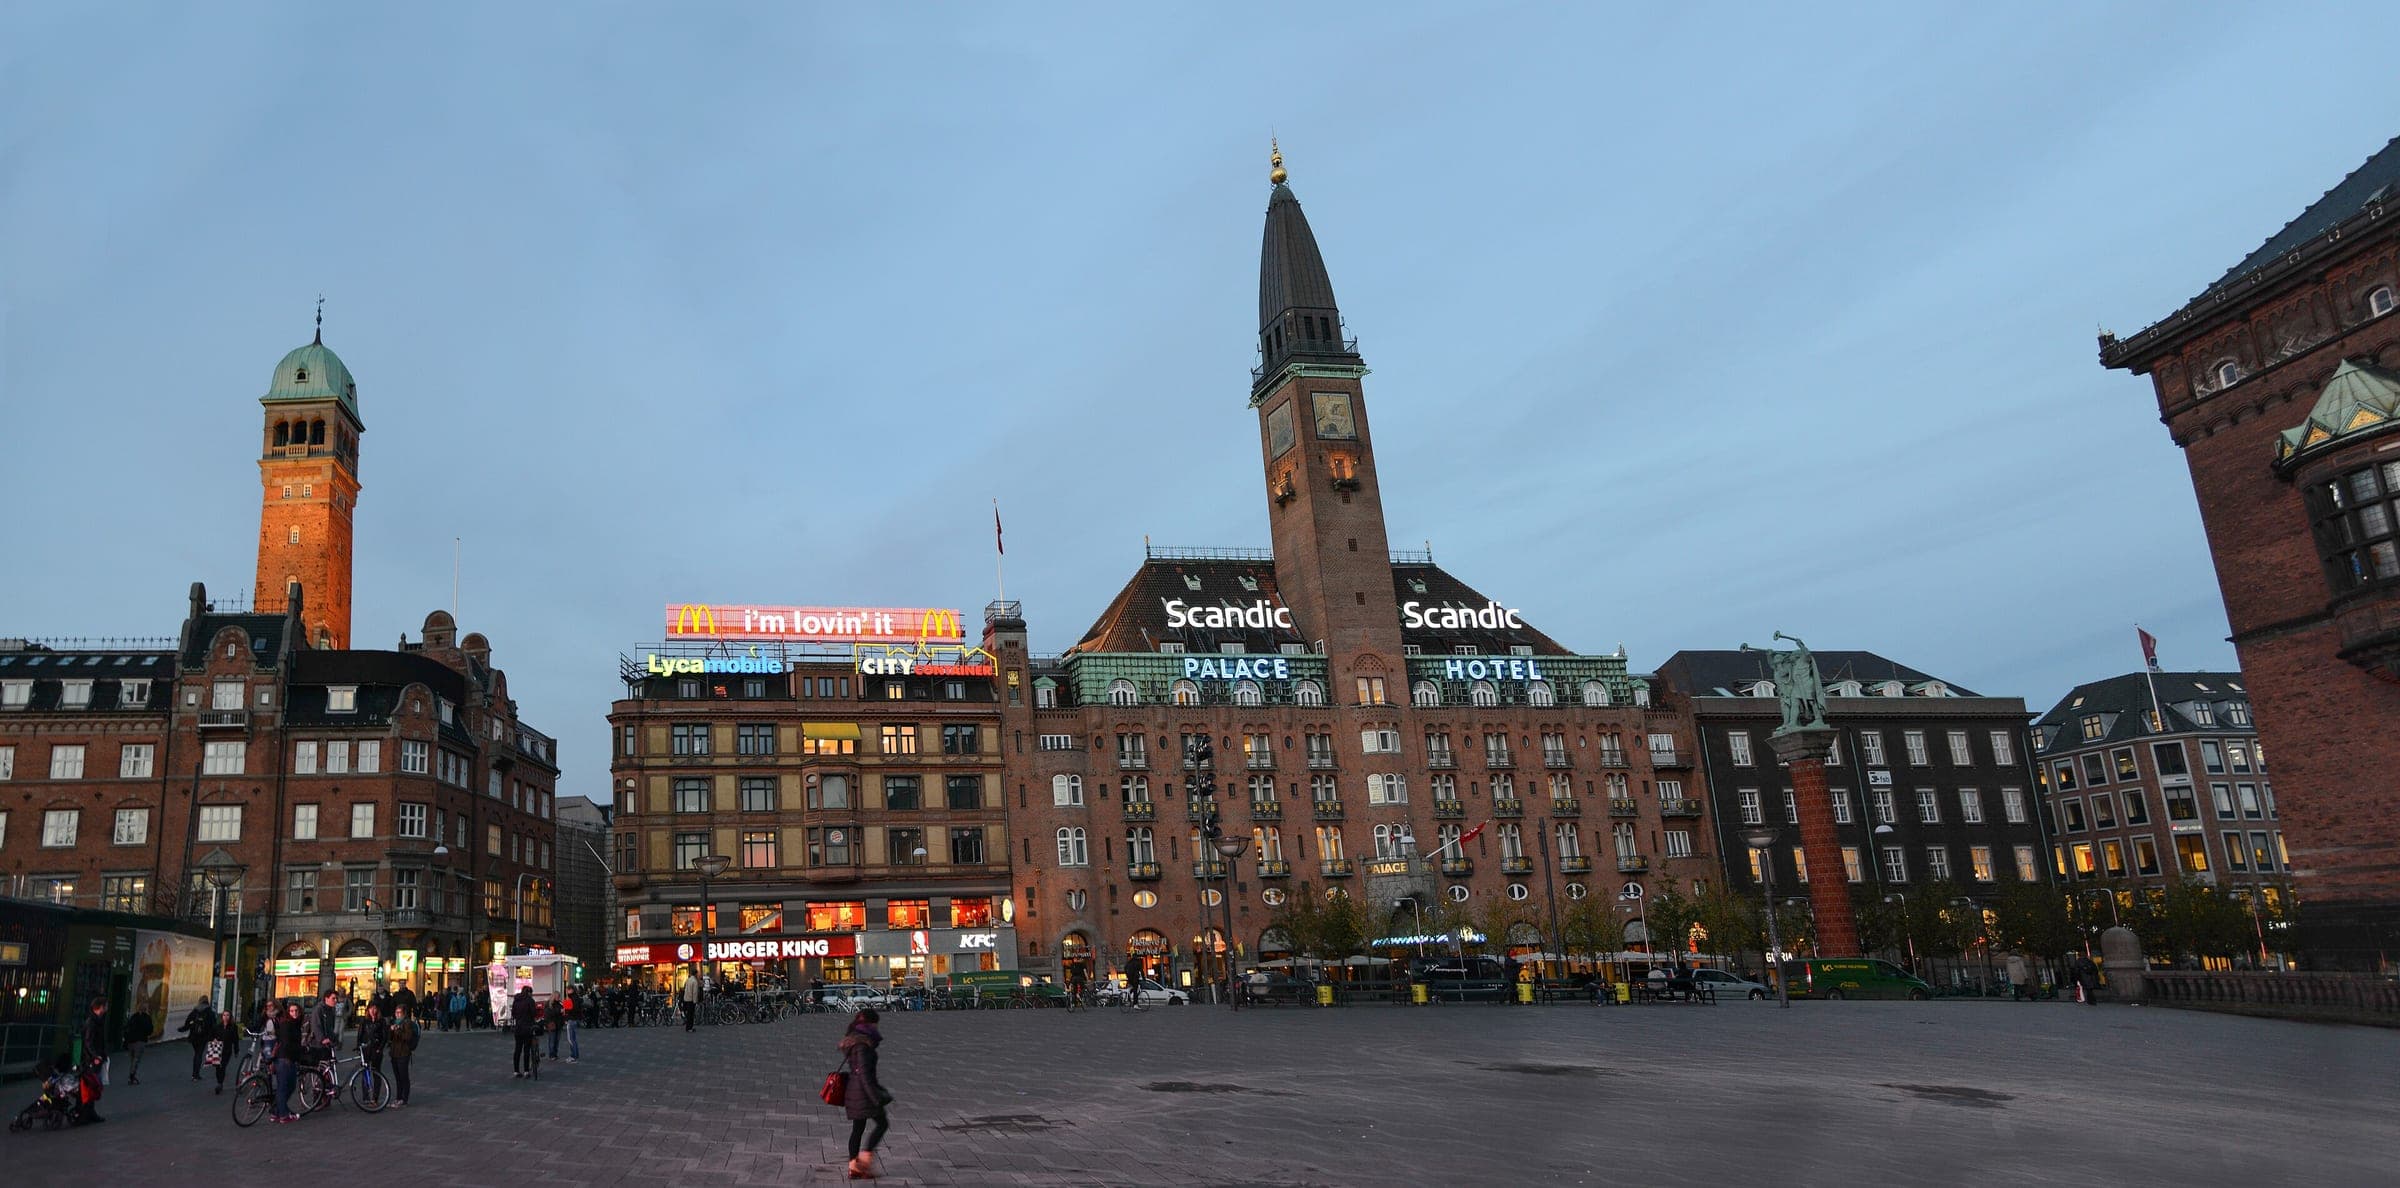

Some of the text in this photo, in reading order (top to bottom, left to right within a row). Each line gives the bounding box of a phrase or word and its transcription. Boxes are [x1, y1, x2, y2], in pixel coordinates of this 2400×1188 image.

[744, 609, 893, 635] i'm lovin' it
[1166, 599, 1291, 629] Scandic
[1403, 601, 1522, 629] Scandic
[648, 650, 783, 677] Lycamobile
[862, 658, 914, 675] CITY
[914, 664, 993, 676] CONTAINER
[1184, 658, 1289, 680] PALACE
[1445, 659, 1542, 681] HOTEL
[708, 941, 779, 959] BURGER
[782, 939, 829, 957] KING
[959, 934, 997, 948] KFC
[1765, 951, 1793, 963] GLRIA
